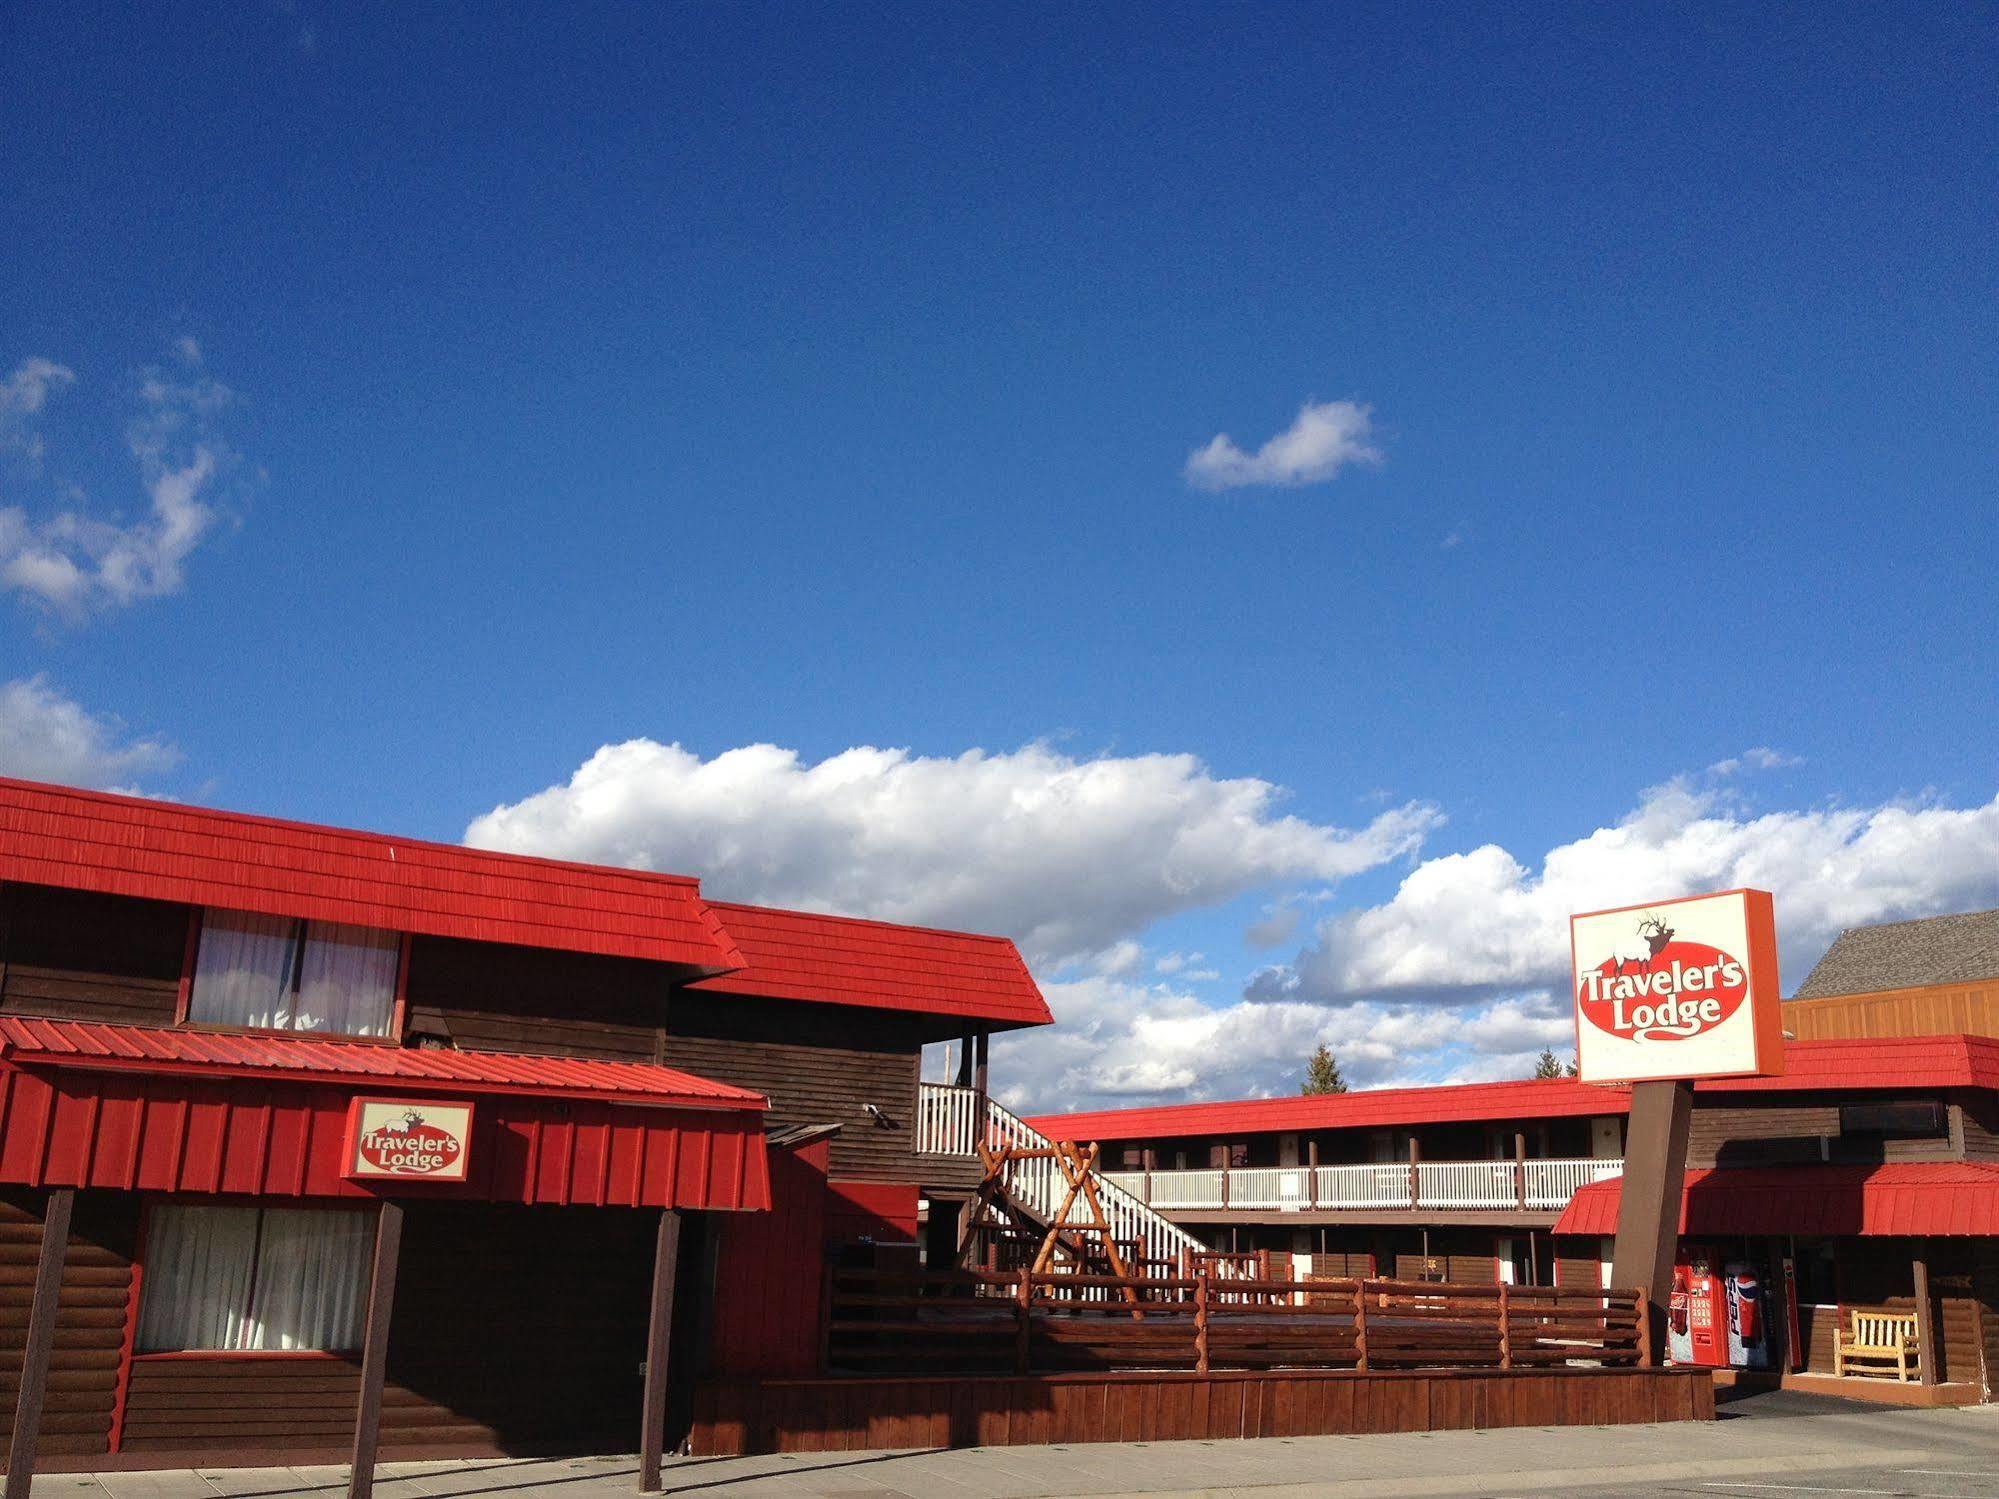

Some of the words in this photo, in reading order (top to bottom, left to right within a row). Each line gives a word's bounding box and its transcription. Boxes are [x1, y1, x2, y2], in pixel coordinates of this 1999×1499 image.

[1581, 953, 1743, 1002] Traveler's
[1612, 992, 1721, 1044] Lodge
[363, 1132, 457, 1152] Traveler's
[380, 1149, 444, 1174] Lodge
